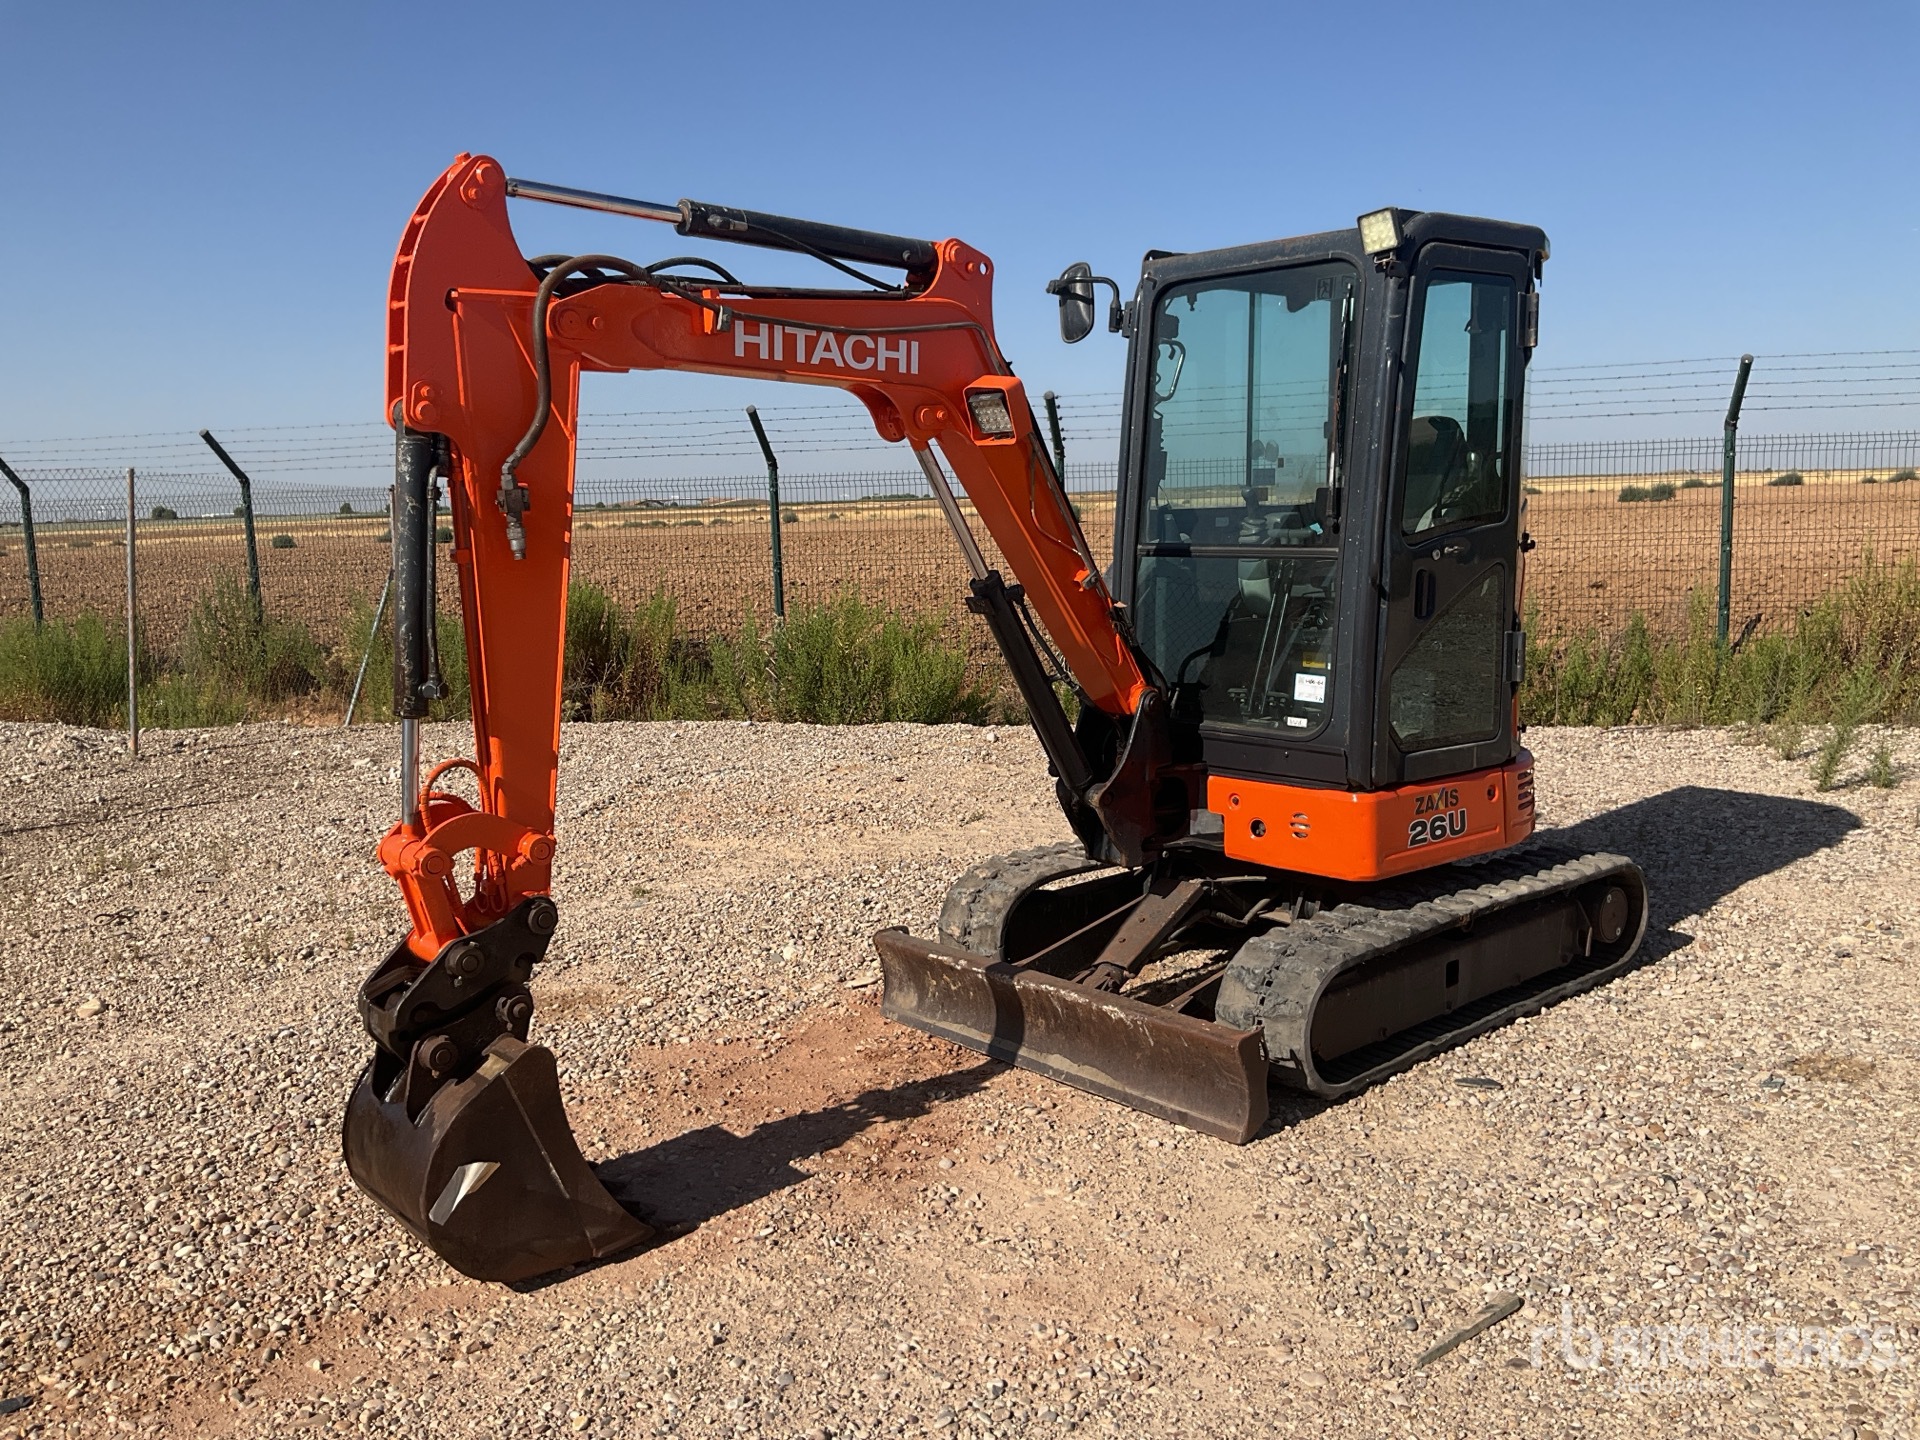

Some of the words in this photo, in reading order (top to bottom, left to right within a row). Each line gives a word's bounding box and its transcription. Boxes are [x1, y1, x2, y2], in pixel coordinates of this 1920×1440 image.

[735, 320, 919, 375] HITACHI
[1414, 787, 1459, 815] ZAXIS
[1408, 809, 1467, 848] 26U
